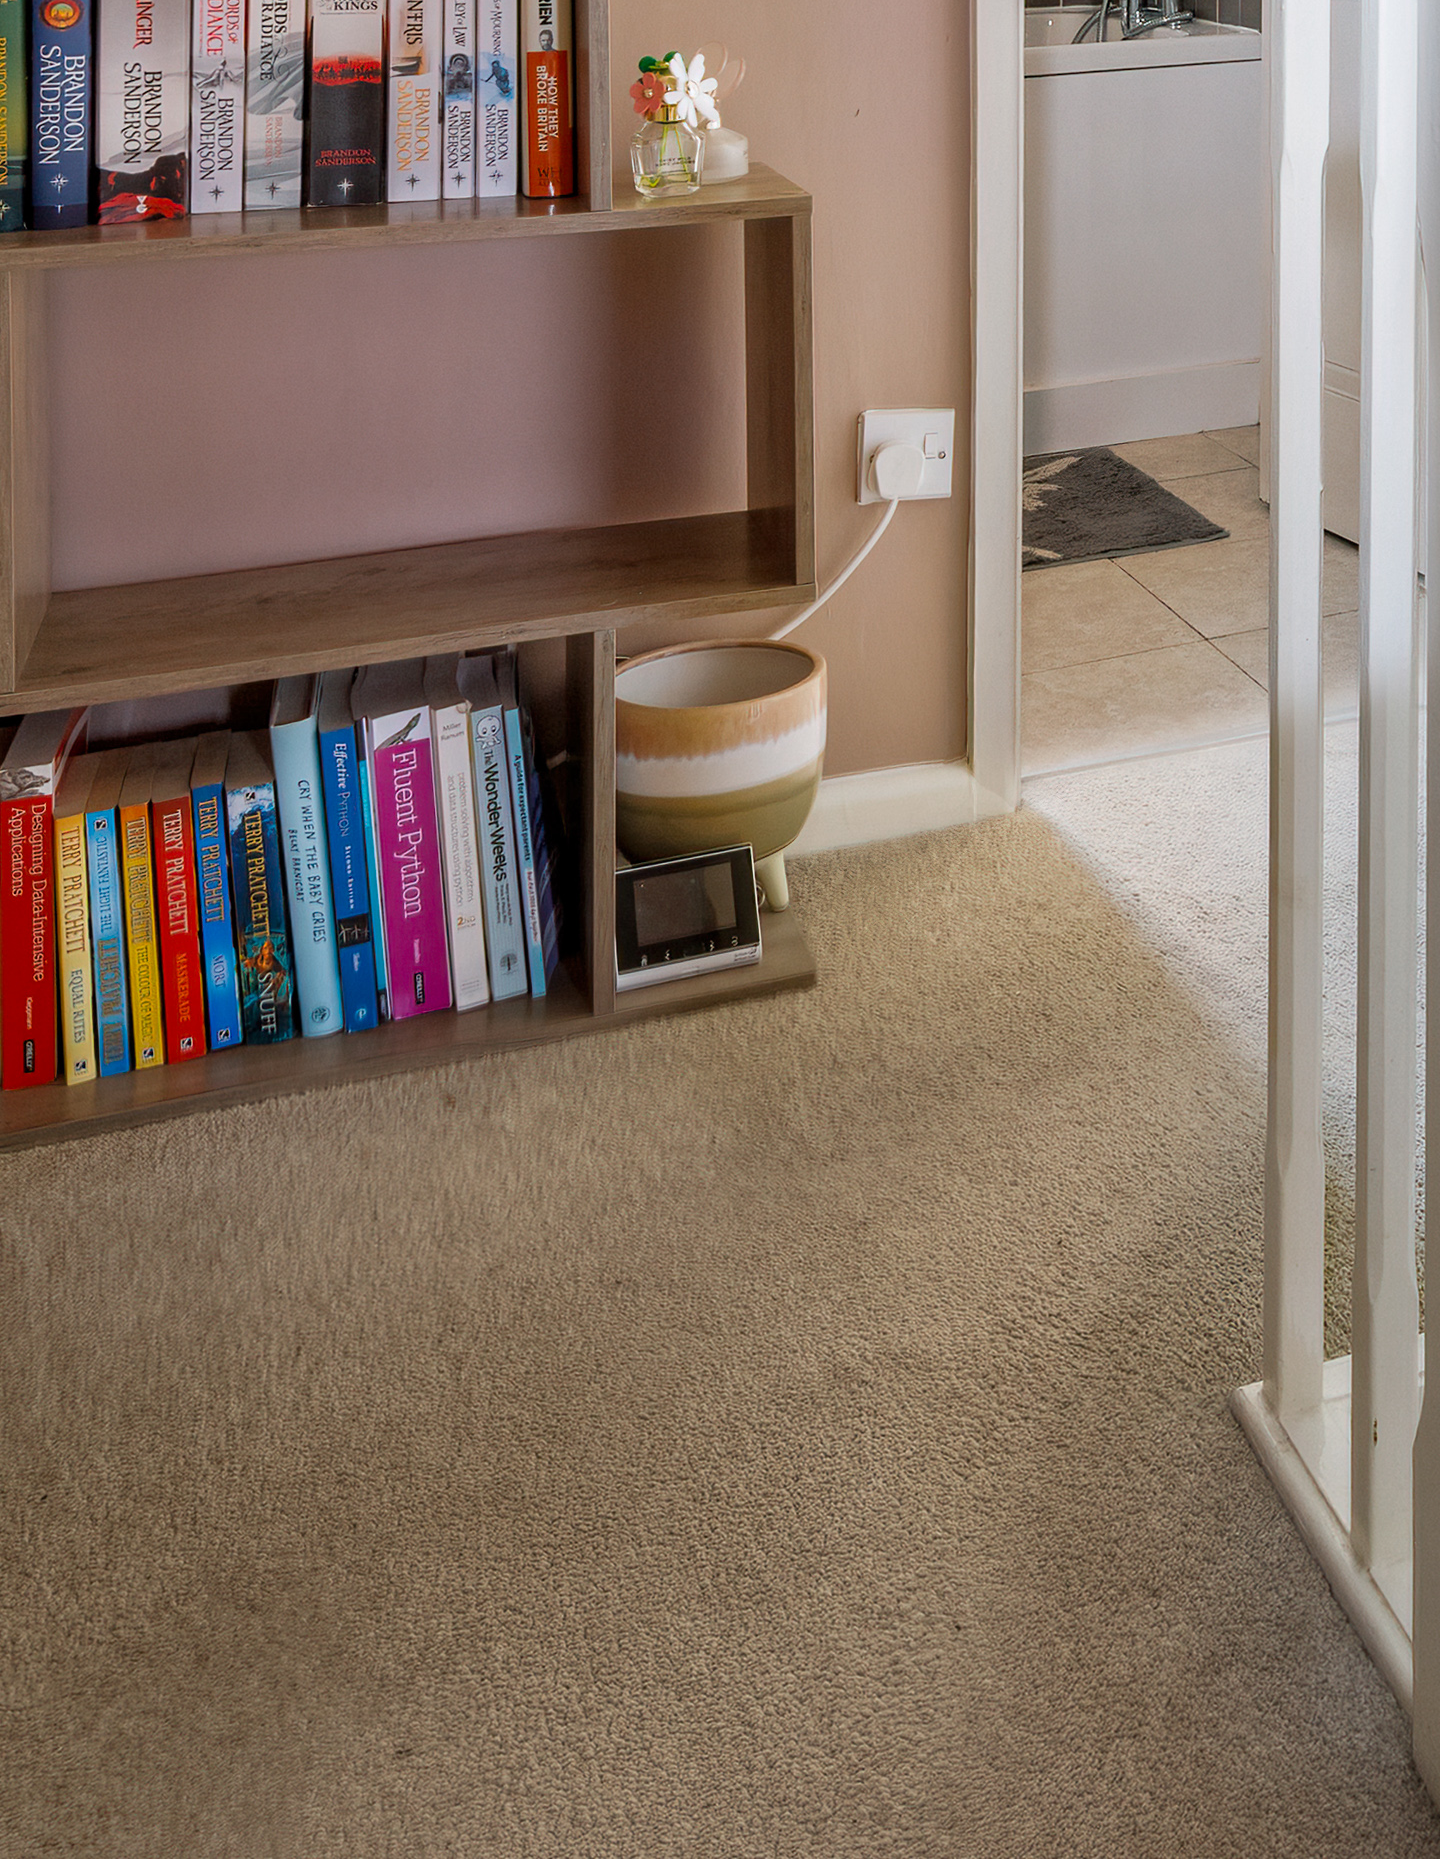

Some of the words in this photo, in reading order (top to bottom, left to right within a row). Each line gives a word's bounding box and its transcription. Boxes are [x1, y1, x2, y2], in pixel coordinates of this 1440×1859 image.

[259, 2, 273, 81] RADIANCE
[332, 0, 379, 11] KINGS
[37, 44, 62, 165] SANDERSON
[61, 53, 86, 152] BRANDON
[121, 62, 142, 164] SANDERSON
[142, 69, 163, 153] BRANDON
[536, 65, 548, 105] BROKE
[546, 76, 559, 105] HOW
[196, 89, 217, 181] SANDERSON
[215, 97, 234, 171] BRANDON
[320, 148, 372, 158] BRANDON
[459, 109, 472, 162] BRANDON
[496, 108, 509, 160] BRANDON
[537, 107, 549, 152] BRITAIN
[548, 108, 559, 139] THEY
[315, 156, 377, 167] SANDERSON
[391, 748, 418, 827] Fluent
[8, 807, 26, 897] Applications
[28, 803, 47, 876] Designing
[60, 825, 82, 869] TERRY
[394, 828, 425, 919] Python
[31, 879, 48, 982] Data-Intensive
[63, 874, 86, 955] PRATCHETT
[257, 971, 277, 1036] SNUFF
